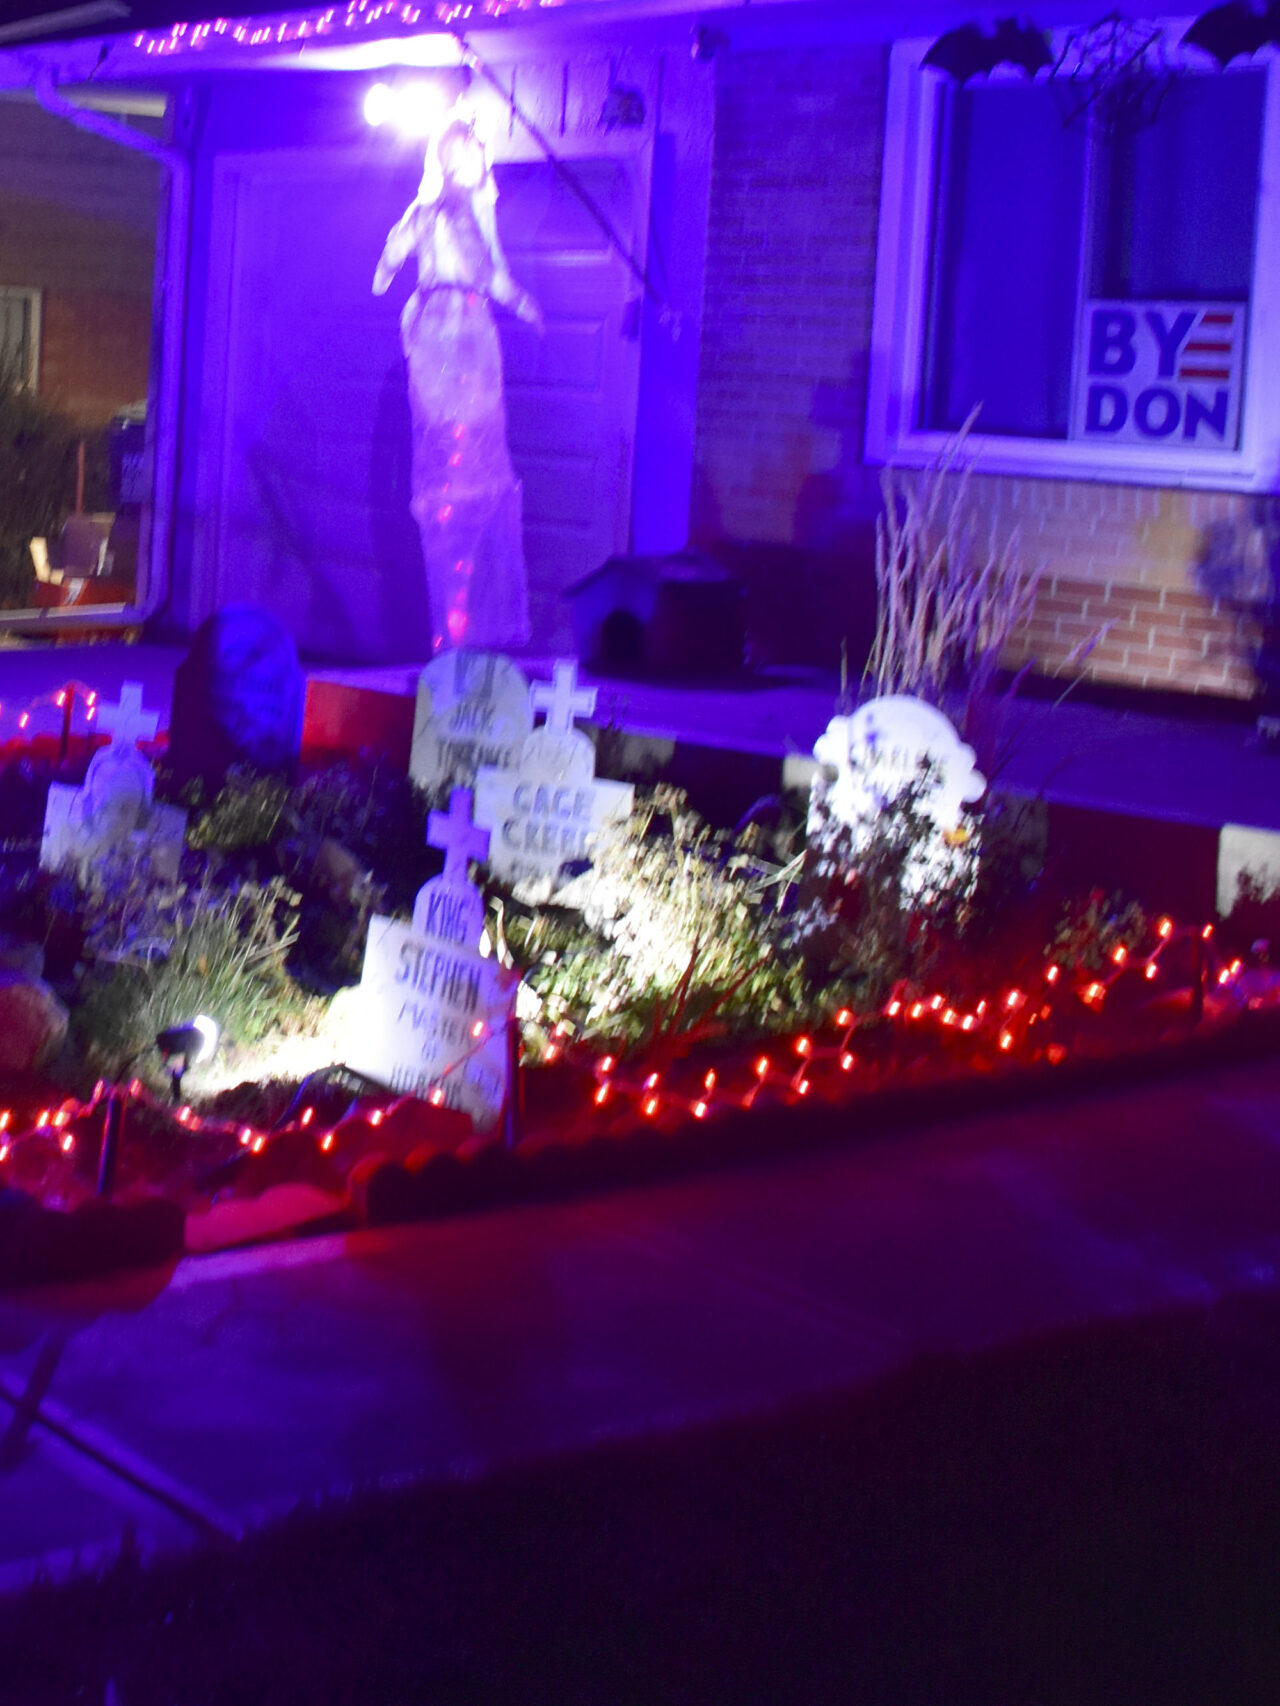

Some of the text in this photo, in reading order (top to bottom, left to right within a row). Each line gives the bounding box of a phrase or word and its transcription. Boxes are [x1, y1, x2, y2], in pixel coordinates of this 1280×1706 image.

[1088, 310, 1234, 380] BYE
[1085, 384, 1229, 441] DON
[425, 890, 471, 946] KING
[396, 938, 483, 1013] STEPHEN
